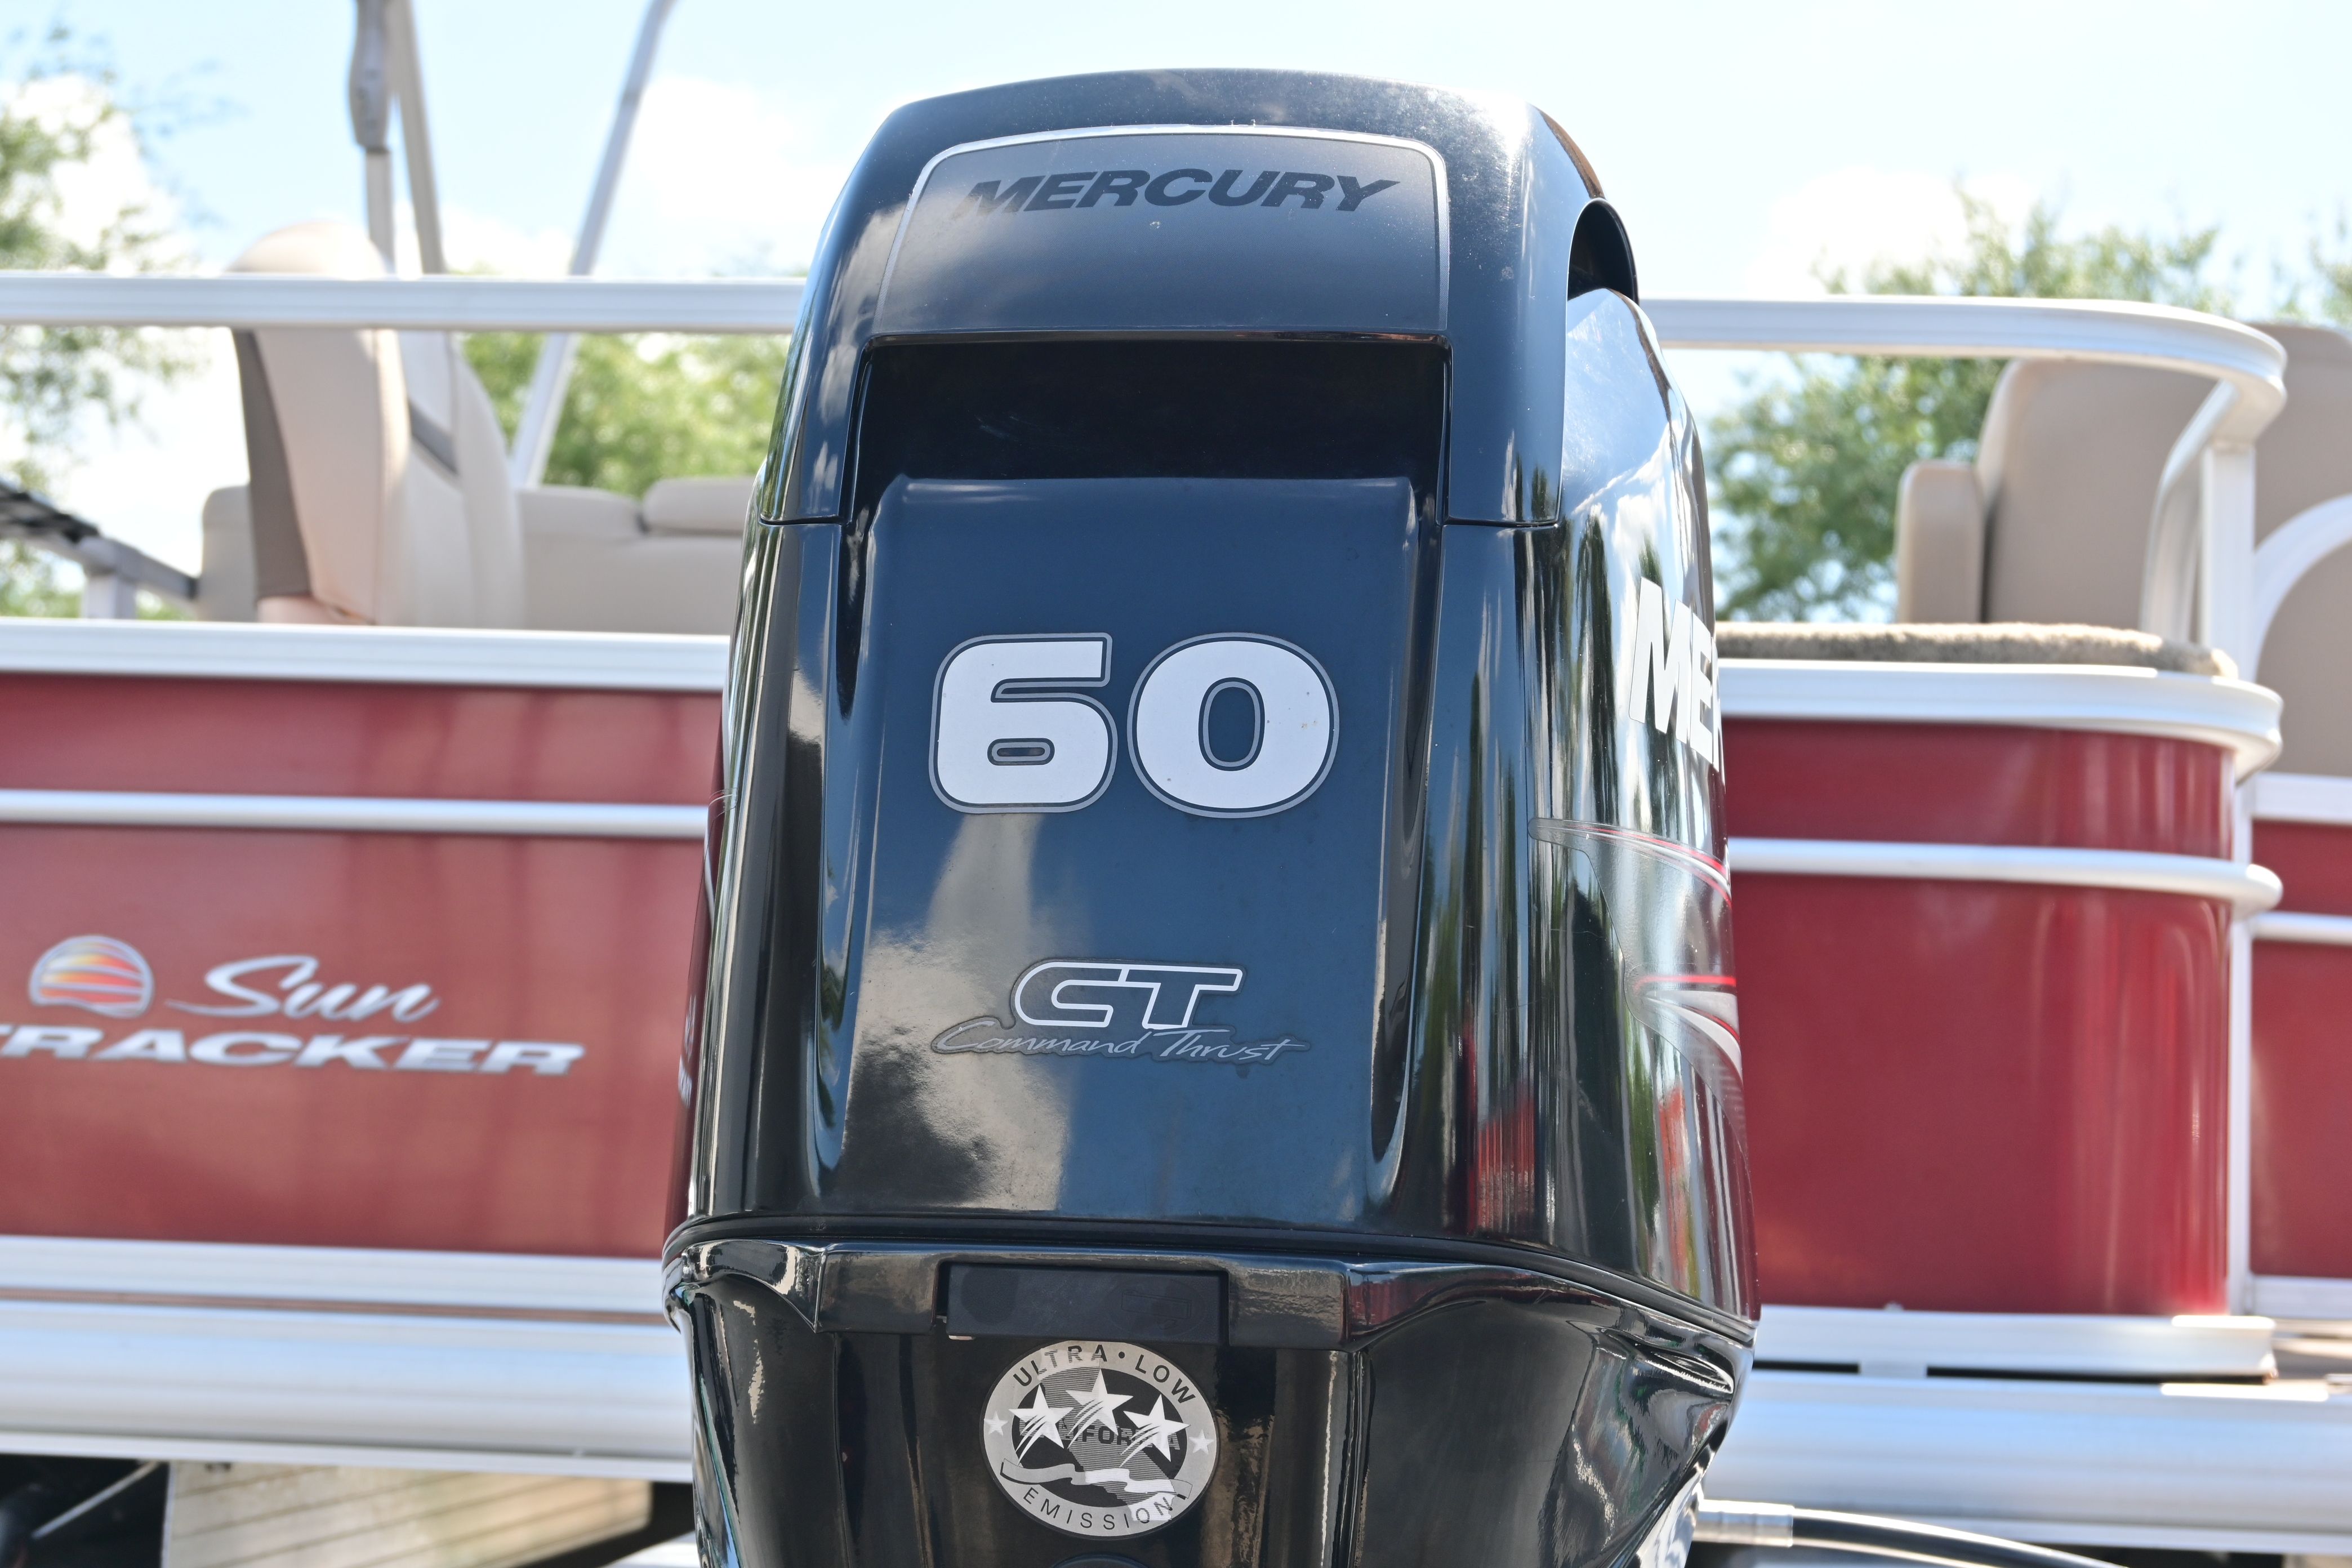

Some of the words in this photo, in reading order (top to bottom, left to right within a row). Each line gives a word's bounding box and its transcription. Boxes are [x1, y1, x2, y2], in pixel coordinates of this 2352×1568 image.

[952, 168, 1400, 218] MERCURY
[1629, 576, 1720, 772] ME
[929, 632, 1340, 818] 60
[164, 955, 439, 1023] Sun
[0, 1024, 585, 1076] RACKER
[936, 1020, 1152, 1054] Command
[1153, 1029, 1306, 1061] Thrust
[1013, 1344, 1108, 1387] ULTRA
[1135, 1354, 1196, 1404] LOW
[1023, 1486, 1173, 1530] EMISSION
